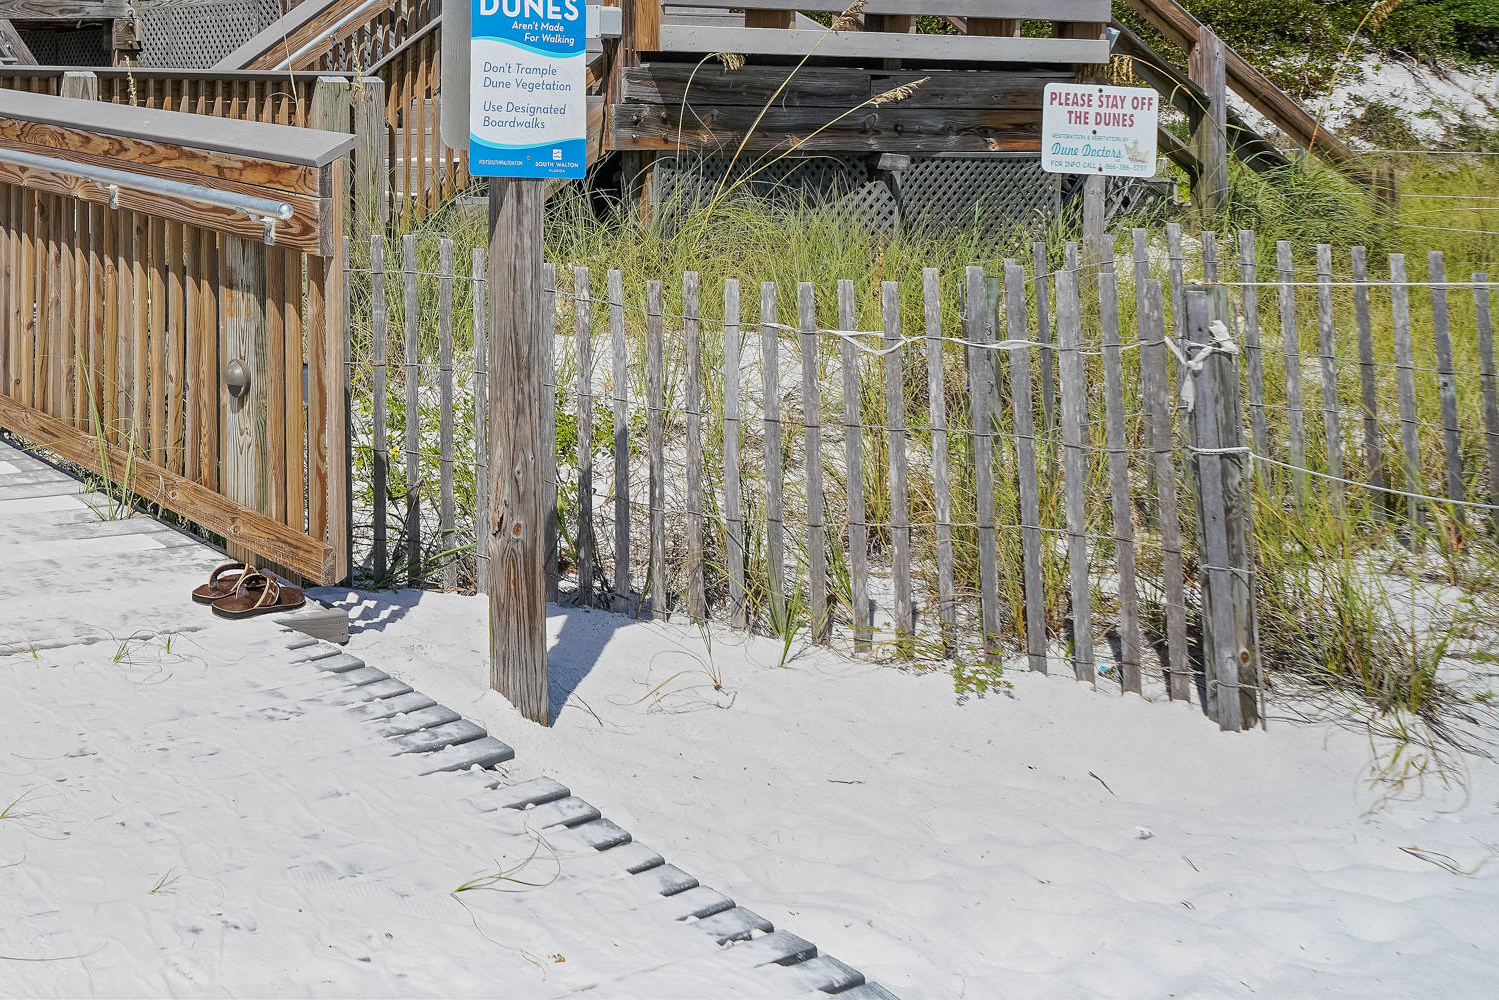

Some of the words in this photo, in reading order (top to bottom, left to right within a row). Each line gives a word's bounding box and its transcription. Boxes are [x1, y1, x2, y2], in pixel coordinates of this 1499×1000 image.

[511, 21, 539, 31] Aren't
[540, 22, 565, 32] Made
[524, 32, 540, 42] For
[542, 33, 575, 47] Walking
[483, 61, 512, 74] Don't
[515, 63, 557, 77] Trample
[483, 76, 511, 88] Dune
[515, 78, 571, 92] Vegetation
[483, 101, 503, 112] Use
[506, 101, 567, 117] Designated
[1050, 91, 1093, 108] PLEASE
[1098, 94, 1126, 110] STAY
[1131, 96, 1154, 111] OFF
[483, 115, 545, 129] Boardwalks
[1067, 110, 1089, 125] THE
[1094, 112, 1135, 128] DUNES
[1051, 142, 1079, 156] Dune
